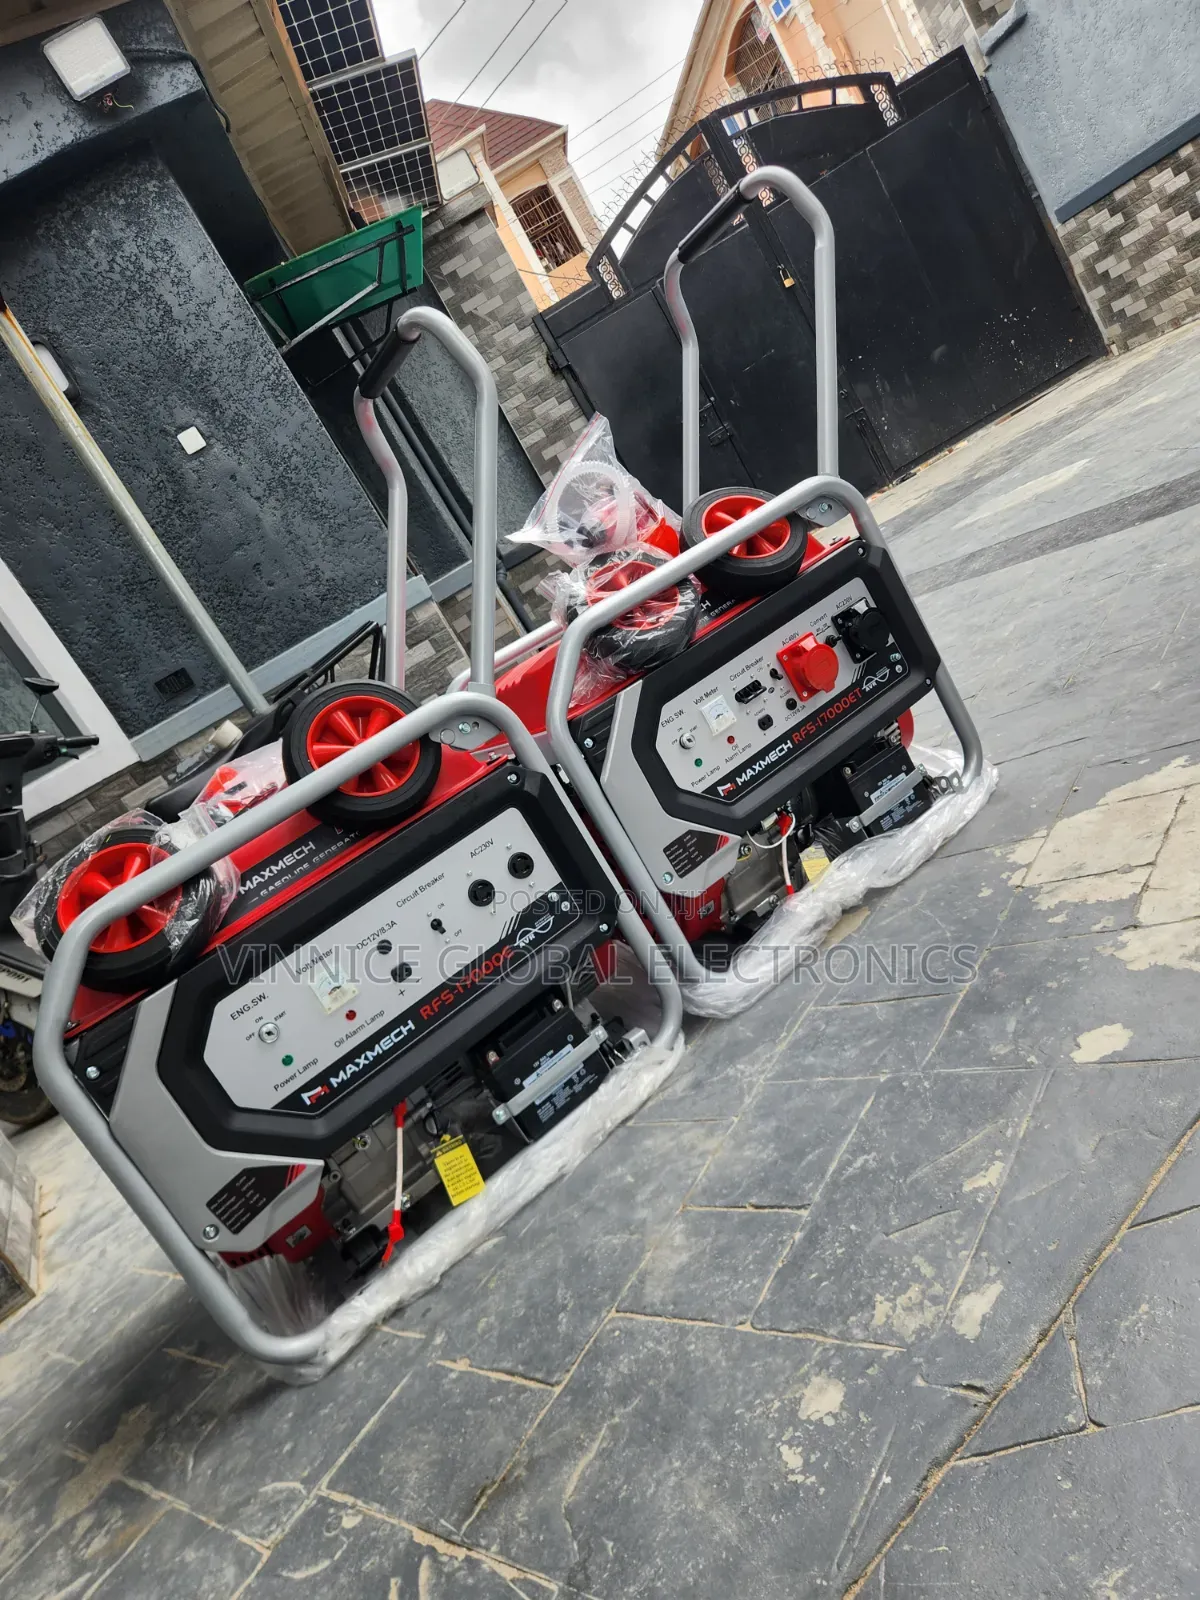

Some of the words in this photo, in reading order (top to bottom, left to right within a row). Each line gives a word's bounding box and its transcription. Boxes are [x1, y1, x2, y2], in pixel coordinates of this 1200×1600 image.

[729, 667, 745, 681] Circuit
[745, 656, 764, 670] Breaker
[693, 694, 704, 706] Volt
[704, 686, 719, 699] Meter
[865, 681, 878, 693] AVR
[732, 744, 740, 752] Oil
[735, 740, 793, 786] MAXMECH
[791, 687, 863, 744] RFS-17000ET
[724, 751, 740, 764] Alarm
[739, 742, 752, 754] Lamp
[691, 774, 706, 788] Power
[705, 765, 721, 778] Lamp
[469, 838, 495, 859] AC230V
[239, 841, 316, 895] MAXMECH
[260, 862, 310, 897] GASOLINE
[396, 888, 419, 908] Circuit
[419, 872, 446, 893] Breaker
[356, 920, 398, 951] DC12V/8.3A
[519, 933, 536, 949] AVR
[230, 992, 269, 1021] ENG.SW.
[329, 1019, 416, 1088] MAXMECH
[419, 945, 515, 1020] RFS-17000E
[334, 1036, 346, 1049] Oil
[345, 1024, 366, 1040] Alarm
[365, 1008, 386, 1027] Lamp
[273, 1071, 298, 1092] Power
[297, 1056, 319, 1076] Lamp
